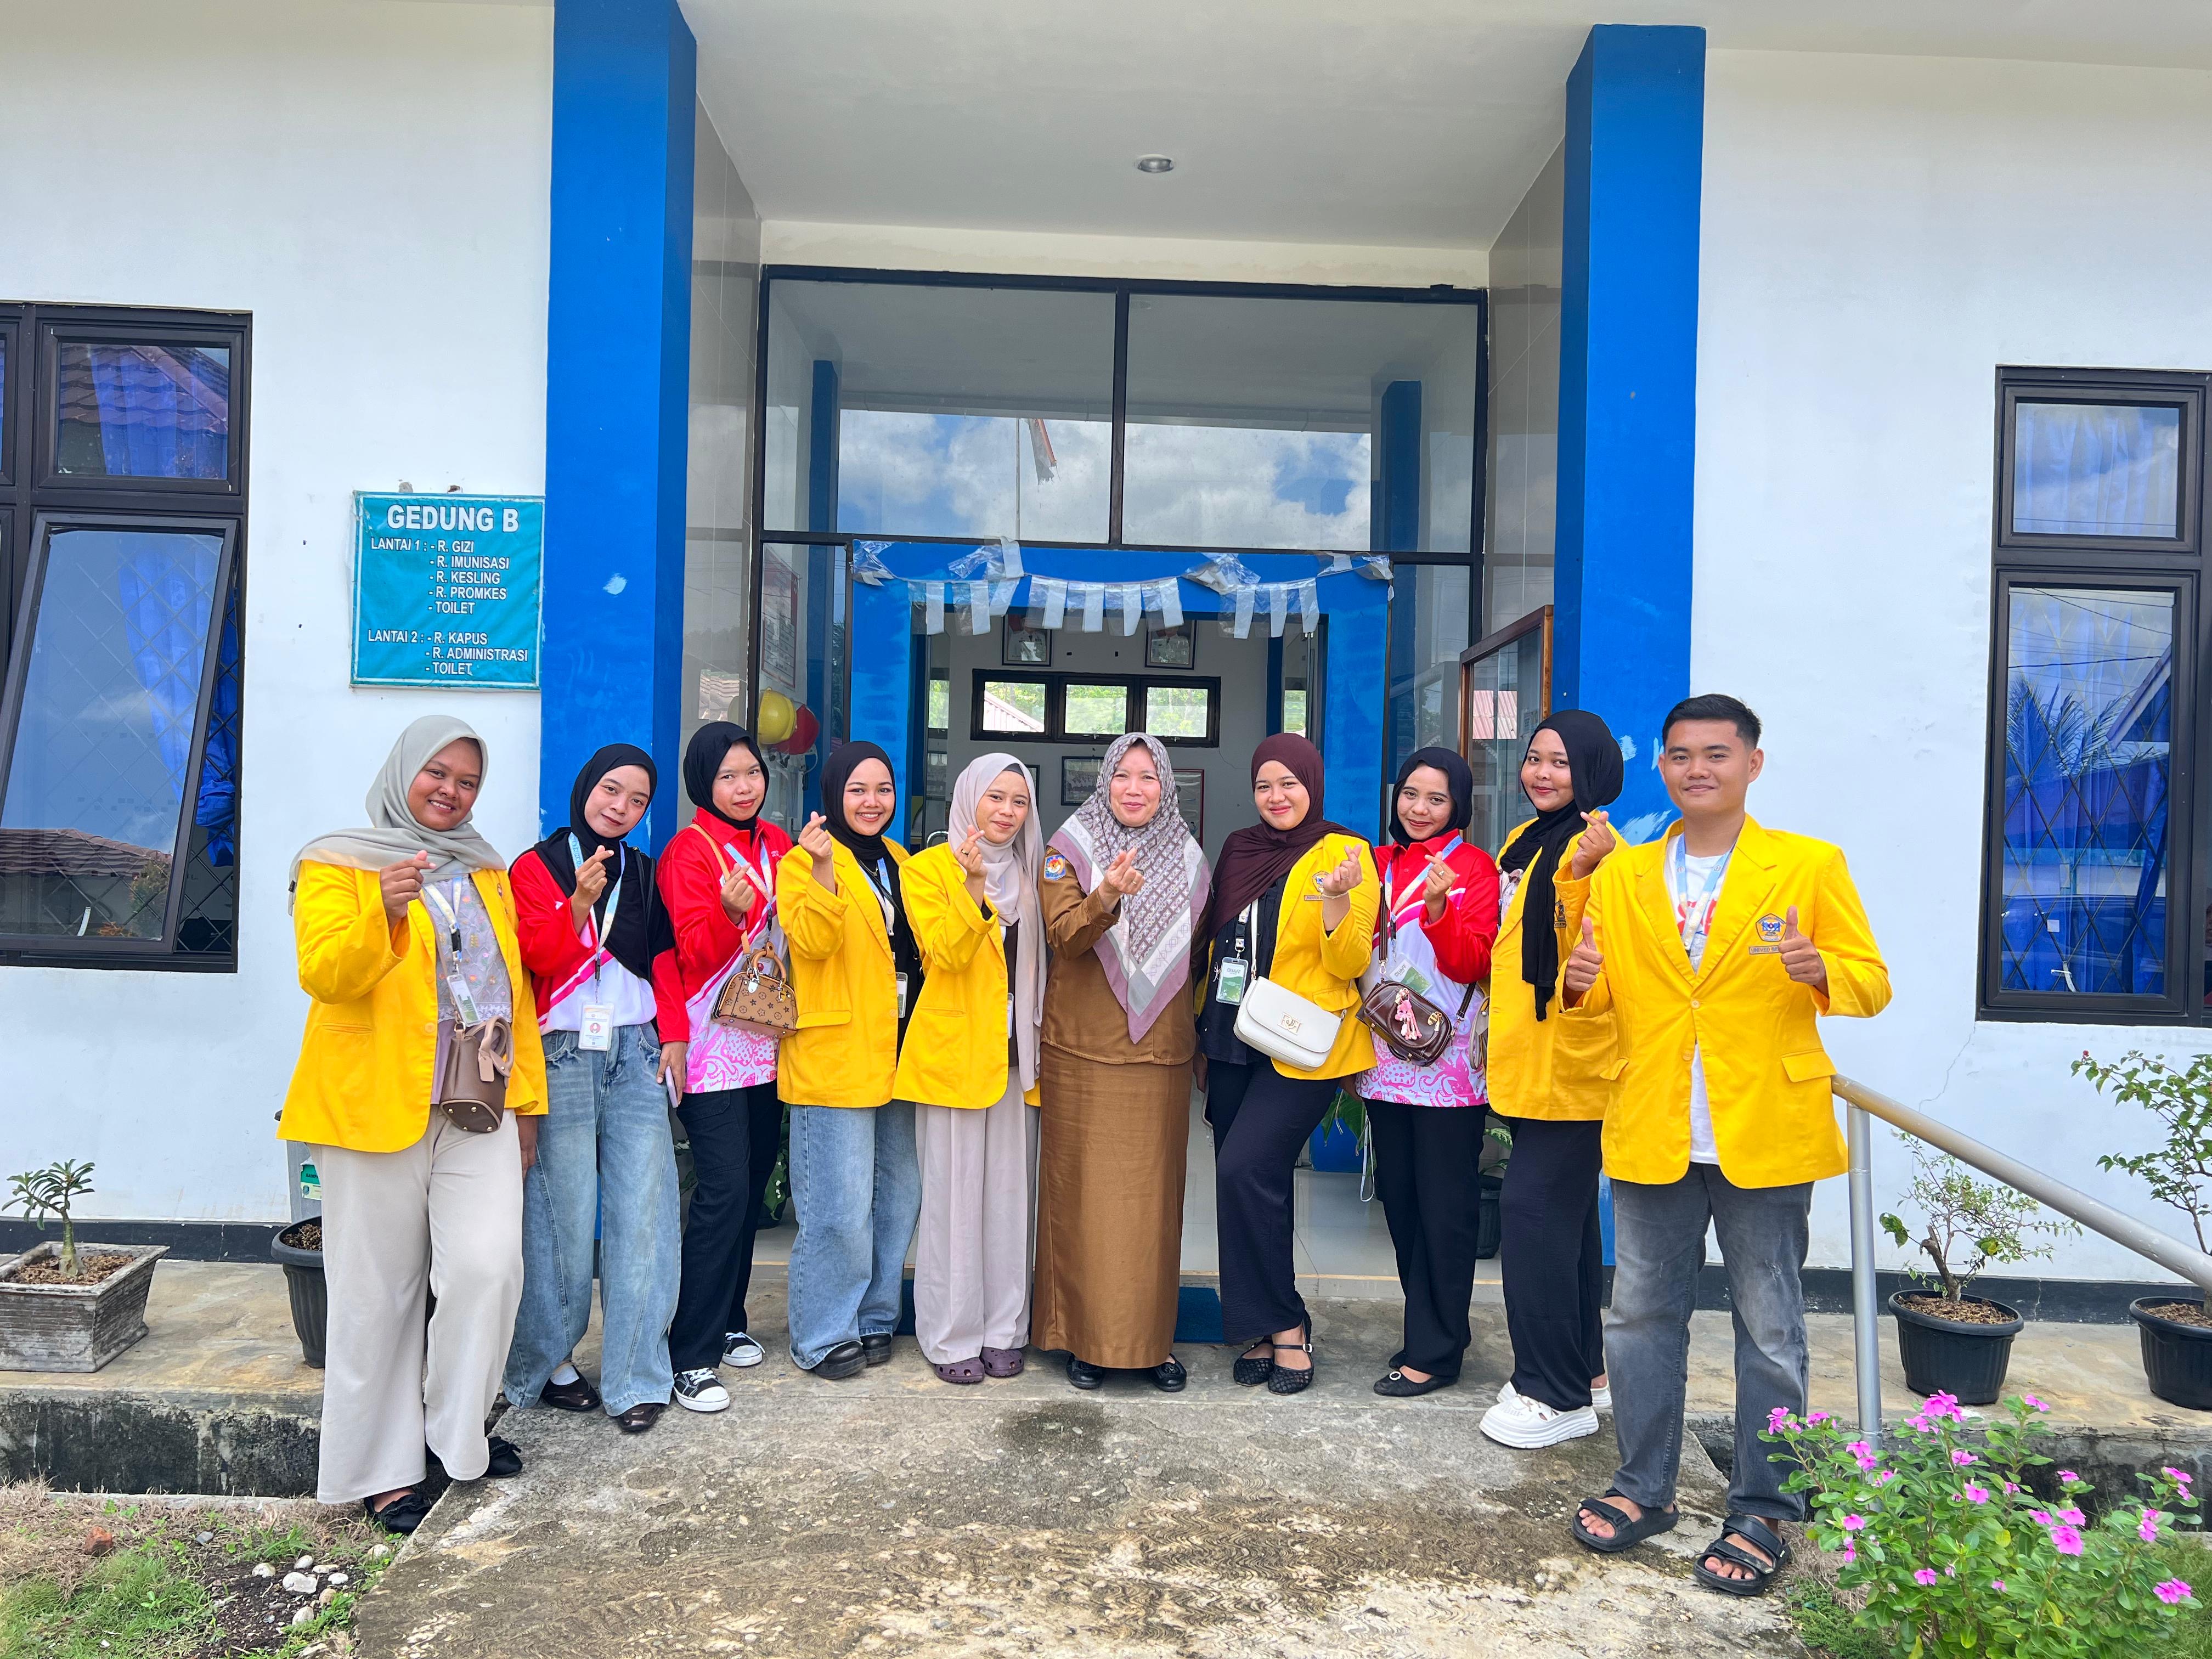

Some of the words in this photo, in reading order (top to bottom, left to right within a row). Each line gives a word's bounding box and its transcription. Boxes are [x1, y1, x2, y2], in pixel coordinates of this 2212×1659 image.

[387, 505, 493, 532] GEDUNG
[502, 508, 520, 532] B
[371, 537, 411, 551] LANTAI
[415, 539, 420, 551] 1
[438, 540, 448, 552] R.
[452, 540, 474, 553] GIZI
[437, 555, 448, 568] R.
[451, 556, 510, 569] IMUNISASI
[436, 571, 447, 583] R.
[450, 571, 500, 584] KESLING
[435, 586, 447, 599] R.
[450, 587, 507, 600] PROMKES
[435, 601, 475, 614] TOILET
[368, 630, 408, 642] LANTAI
[411, 631, 417, 643] 2
[434, 632, 445, 644] R.
[448, 632, 487, 645] KAPUS
[432, 647, 444, 659] R.
[447, 647, 528, 662] ADMINISTRASI
[432, 662, 473, 675] TOILET
